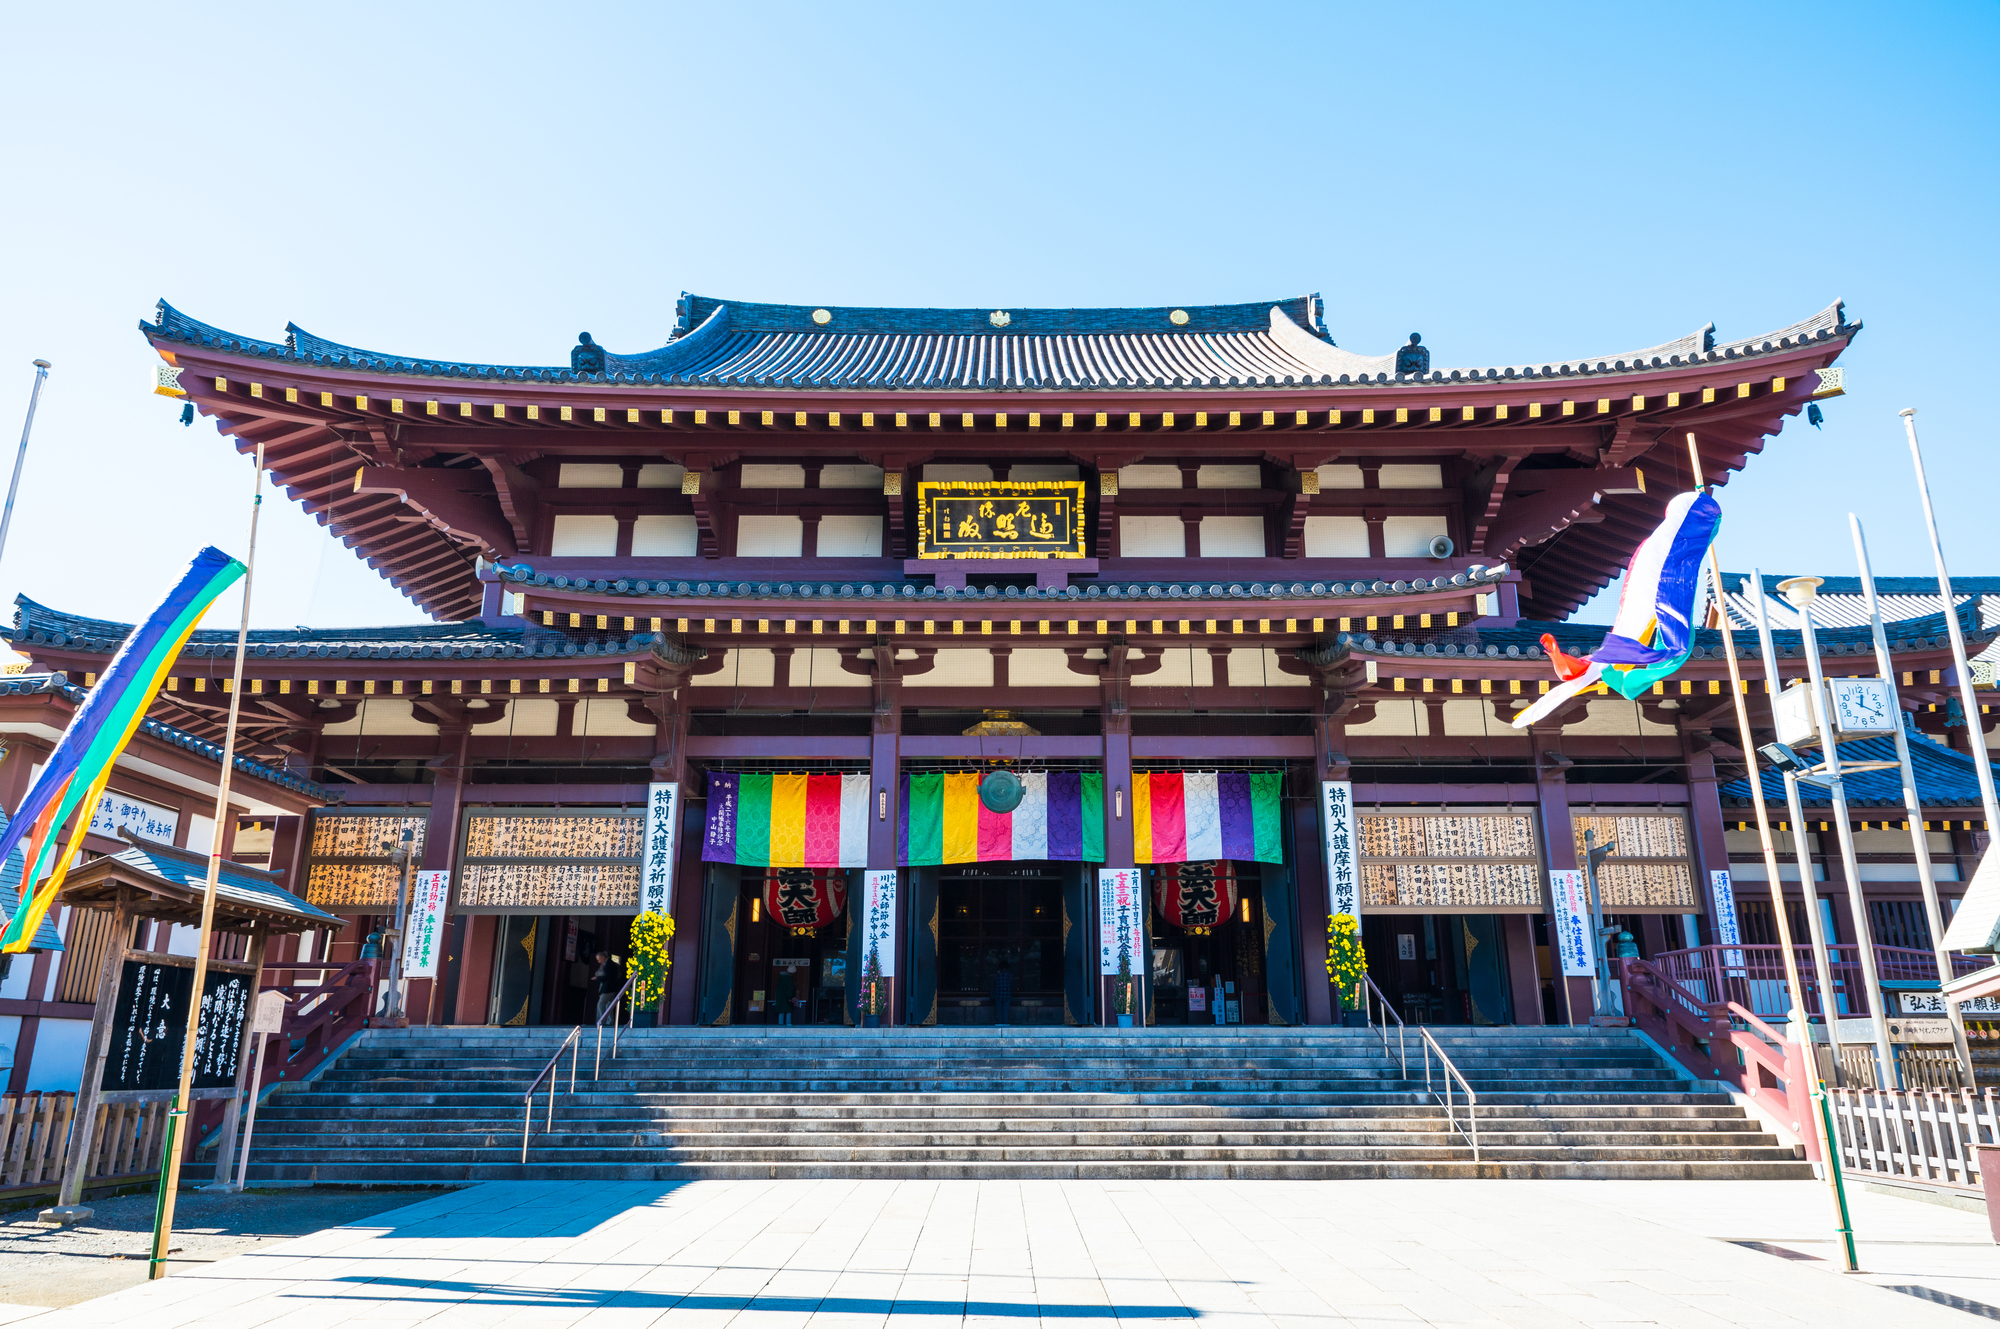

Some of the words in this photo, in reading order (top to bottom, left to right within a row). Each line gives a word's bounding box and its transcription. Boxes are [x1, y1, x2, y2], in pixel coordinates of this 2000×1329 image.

[146, 818, 173, 839] 授与所
[724, 794, 732, 844] 平成二十六年五月
[439, 875, 448, 903] 令和二年
[880, 874, 889, 939] 川崎大師節分会
[1177, 860, 1221, 926] 法大師
[1575, 874, 1584, 903] 令和二年
[419, 914, 436, 968] 奉仕員募集
[1570, 915, 1587, 968] 奉仕員募集
[156, 993, 171, 1039] 大意
[227, 989, 248, 1078] お大師さまのことば
